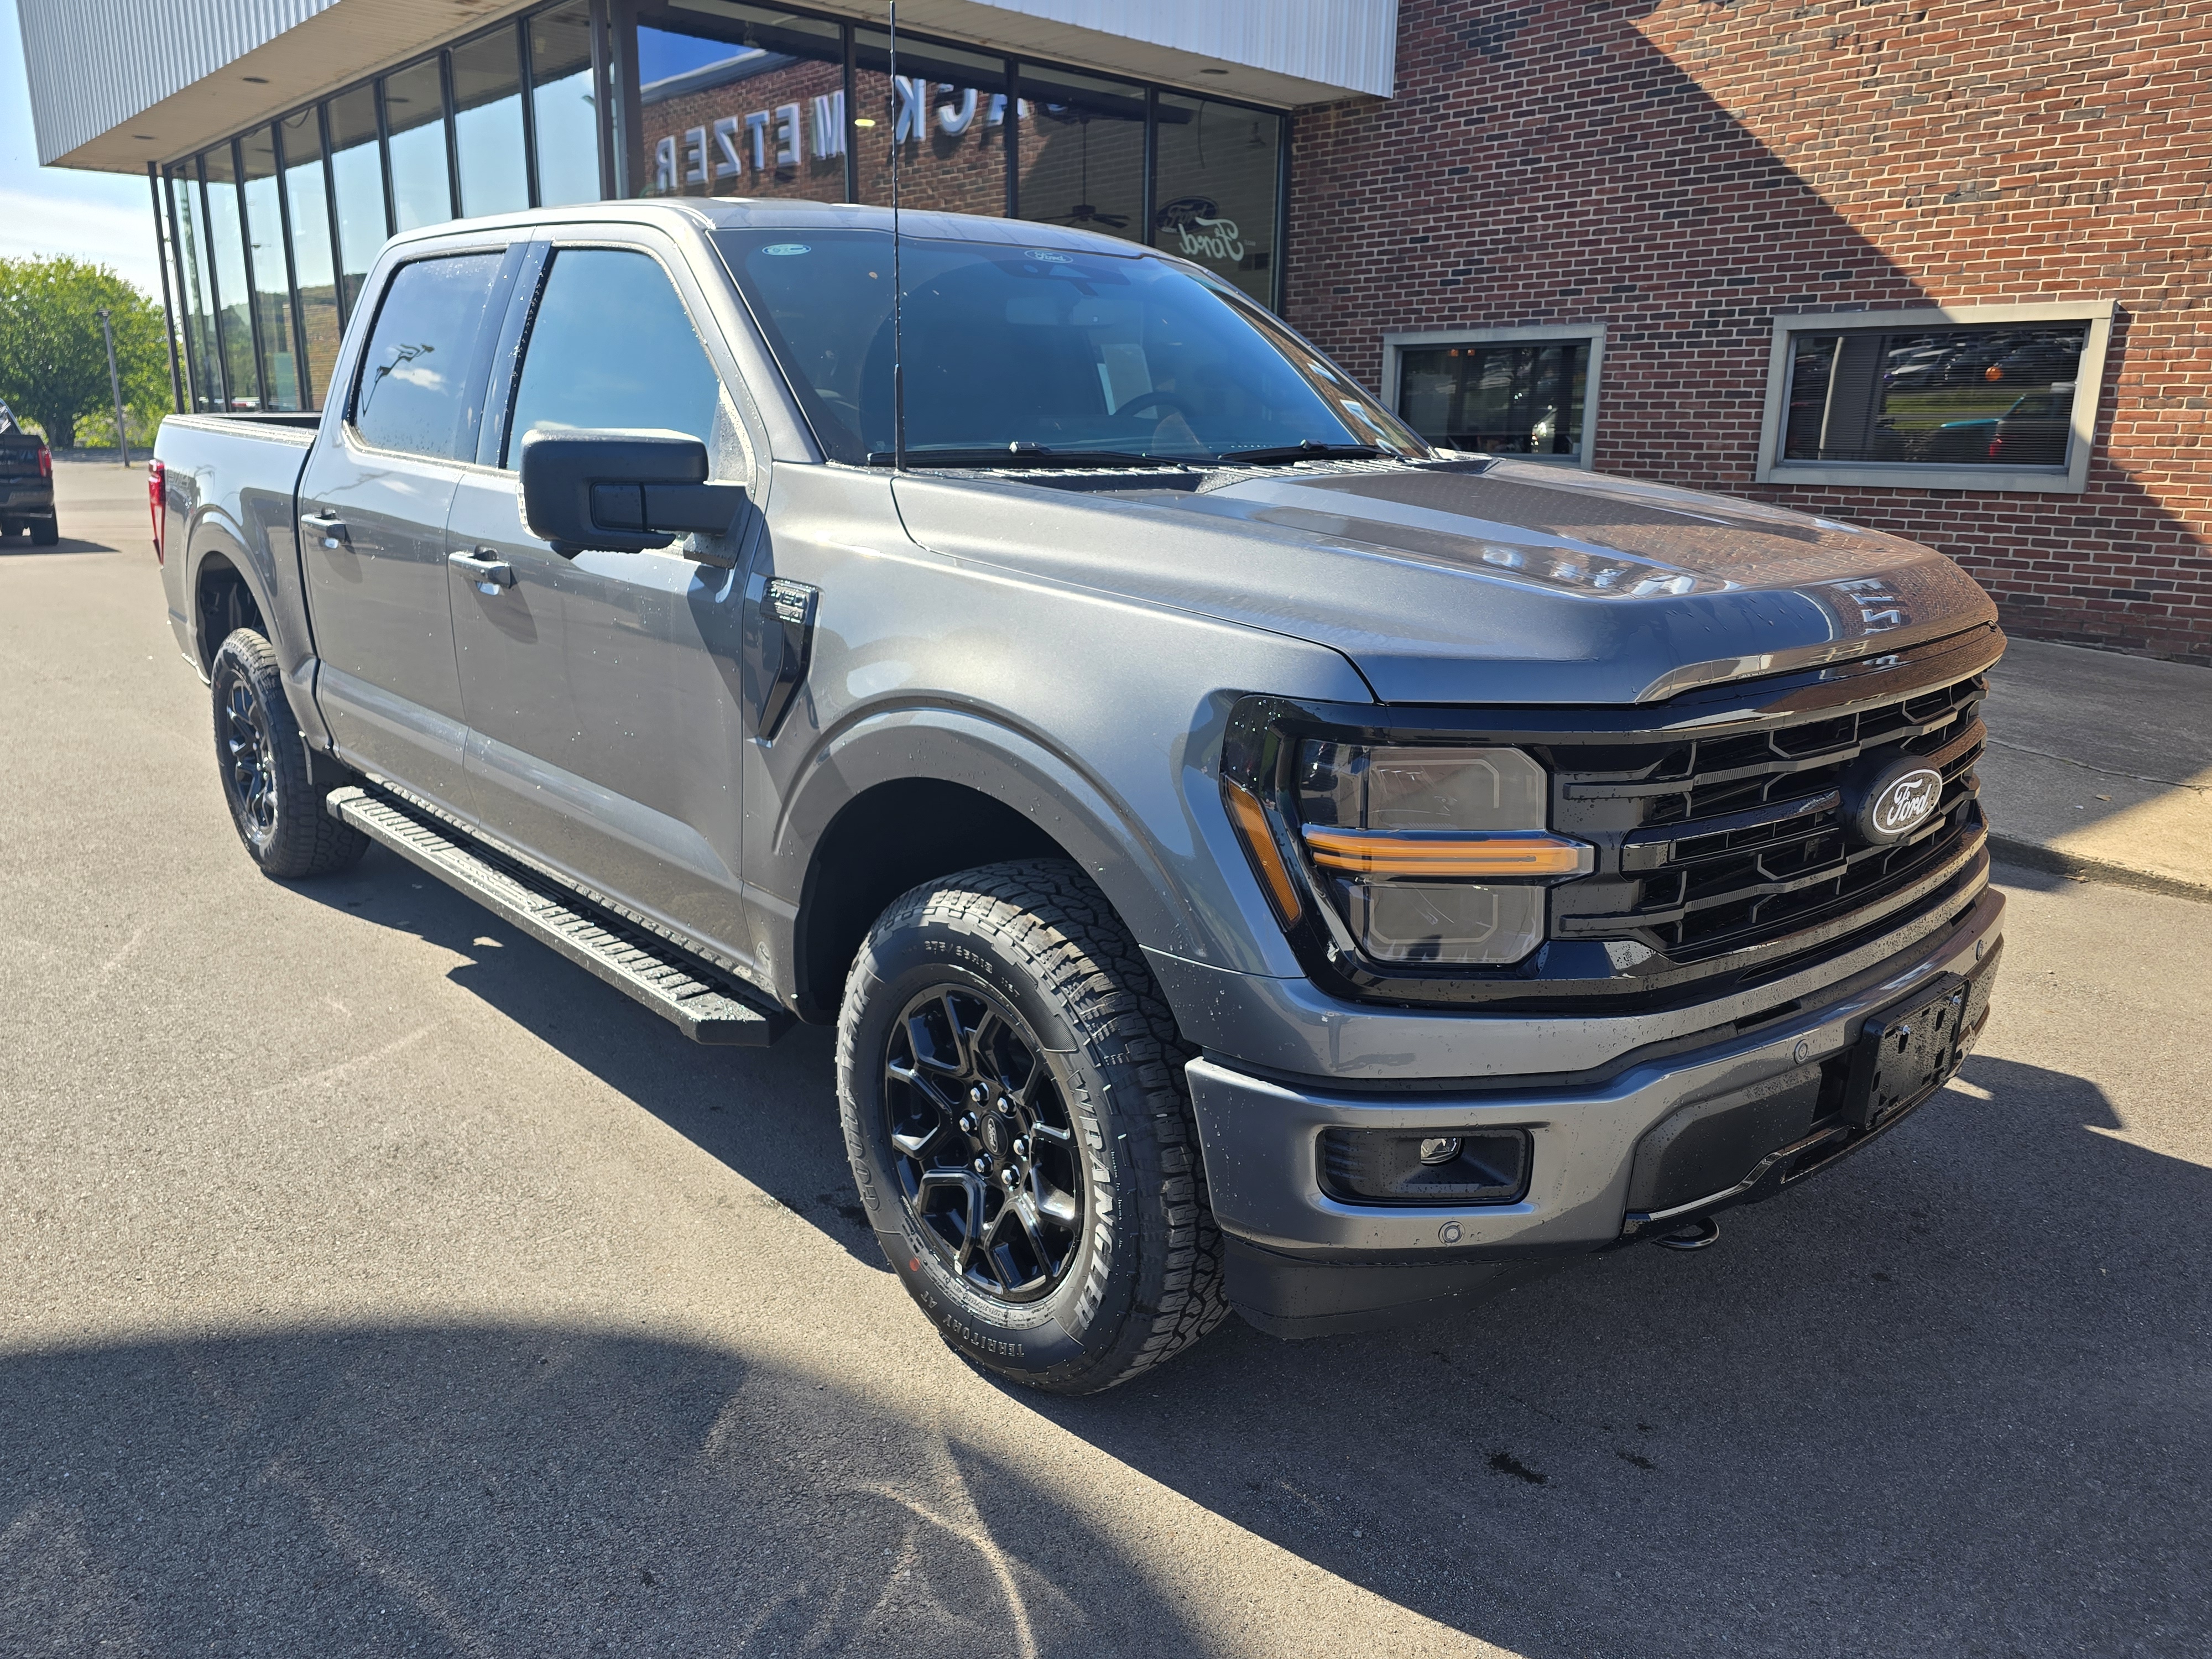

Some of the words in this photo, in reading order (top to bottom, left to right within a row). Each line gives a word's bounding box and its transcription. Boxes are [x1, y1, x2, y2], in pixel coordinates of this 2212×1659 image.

[1887, 778, 1932, 826] Ford
[839, 981, 879, 1211] GOODYEAR
[1067, 1070, 1114, 1329] WRANGLER
[920, 1291, 937, 1308] AT
[942, 1314, 1025, 1357] TERRITORY
